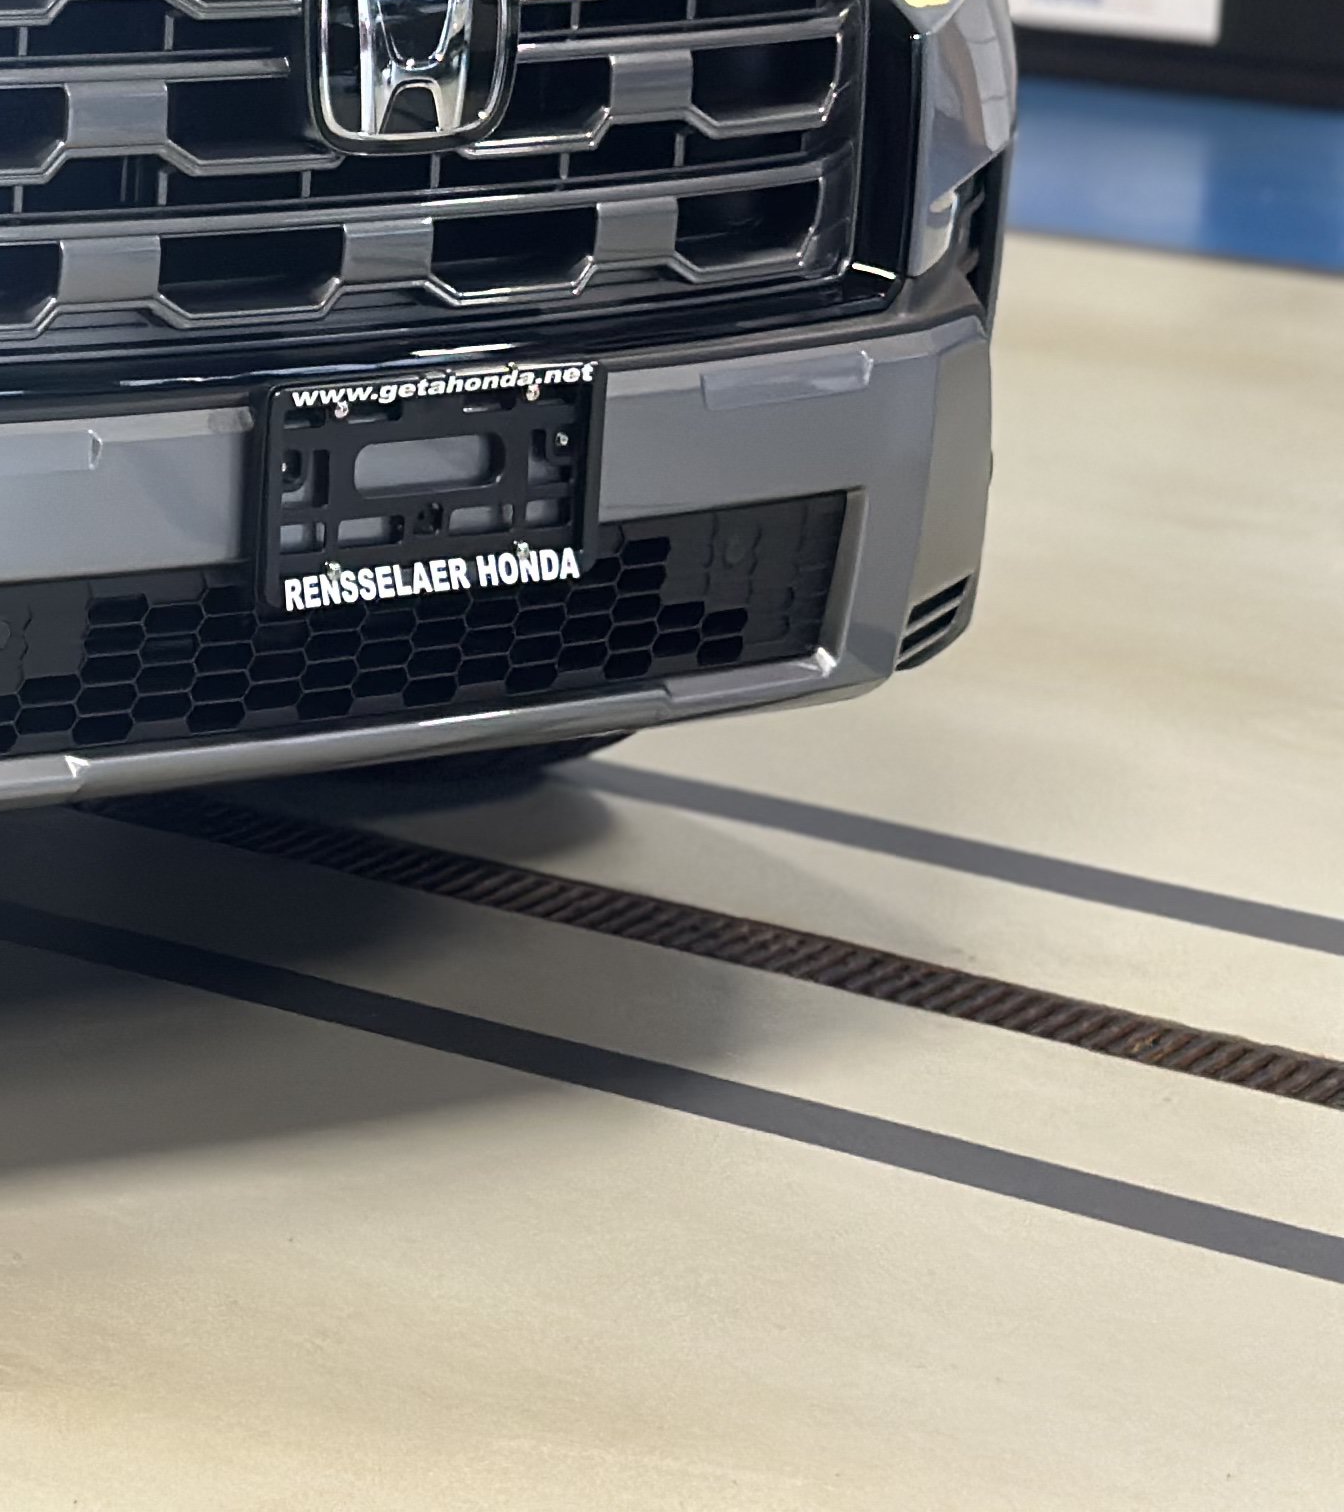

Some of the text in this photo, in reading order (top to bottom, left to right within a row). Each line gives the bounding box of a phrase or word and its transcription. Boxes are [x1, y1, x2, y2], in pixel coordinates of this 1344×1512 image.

[292, 363, 595, 407] www.getahonda.net
[284, 546, 581, 612] RENSSELAER HONDA
